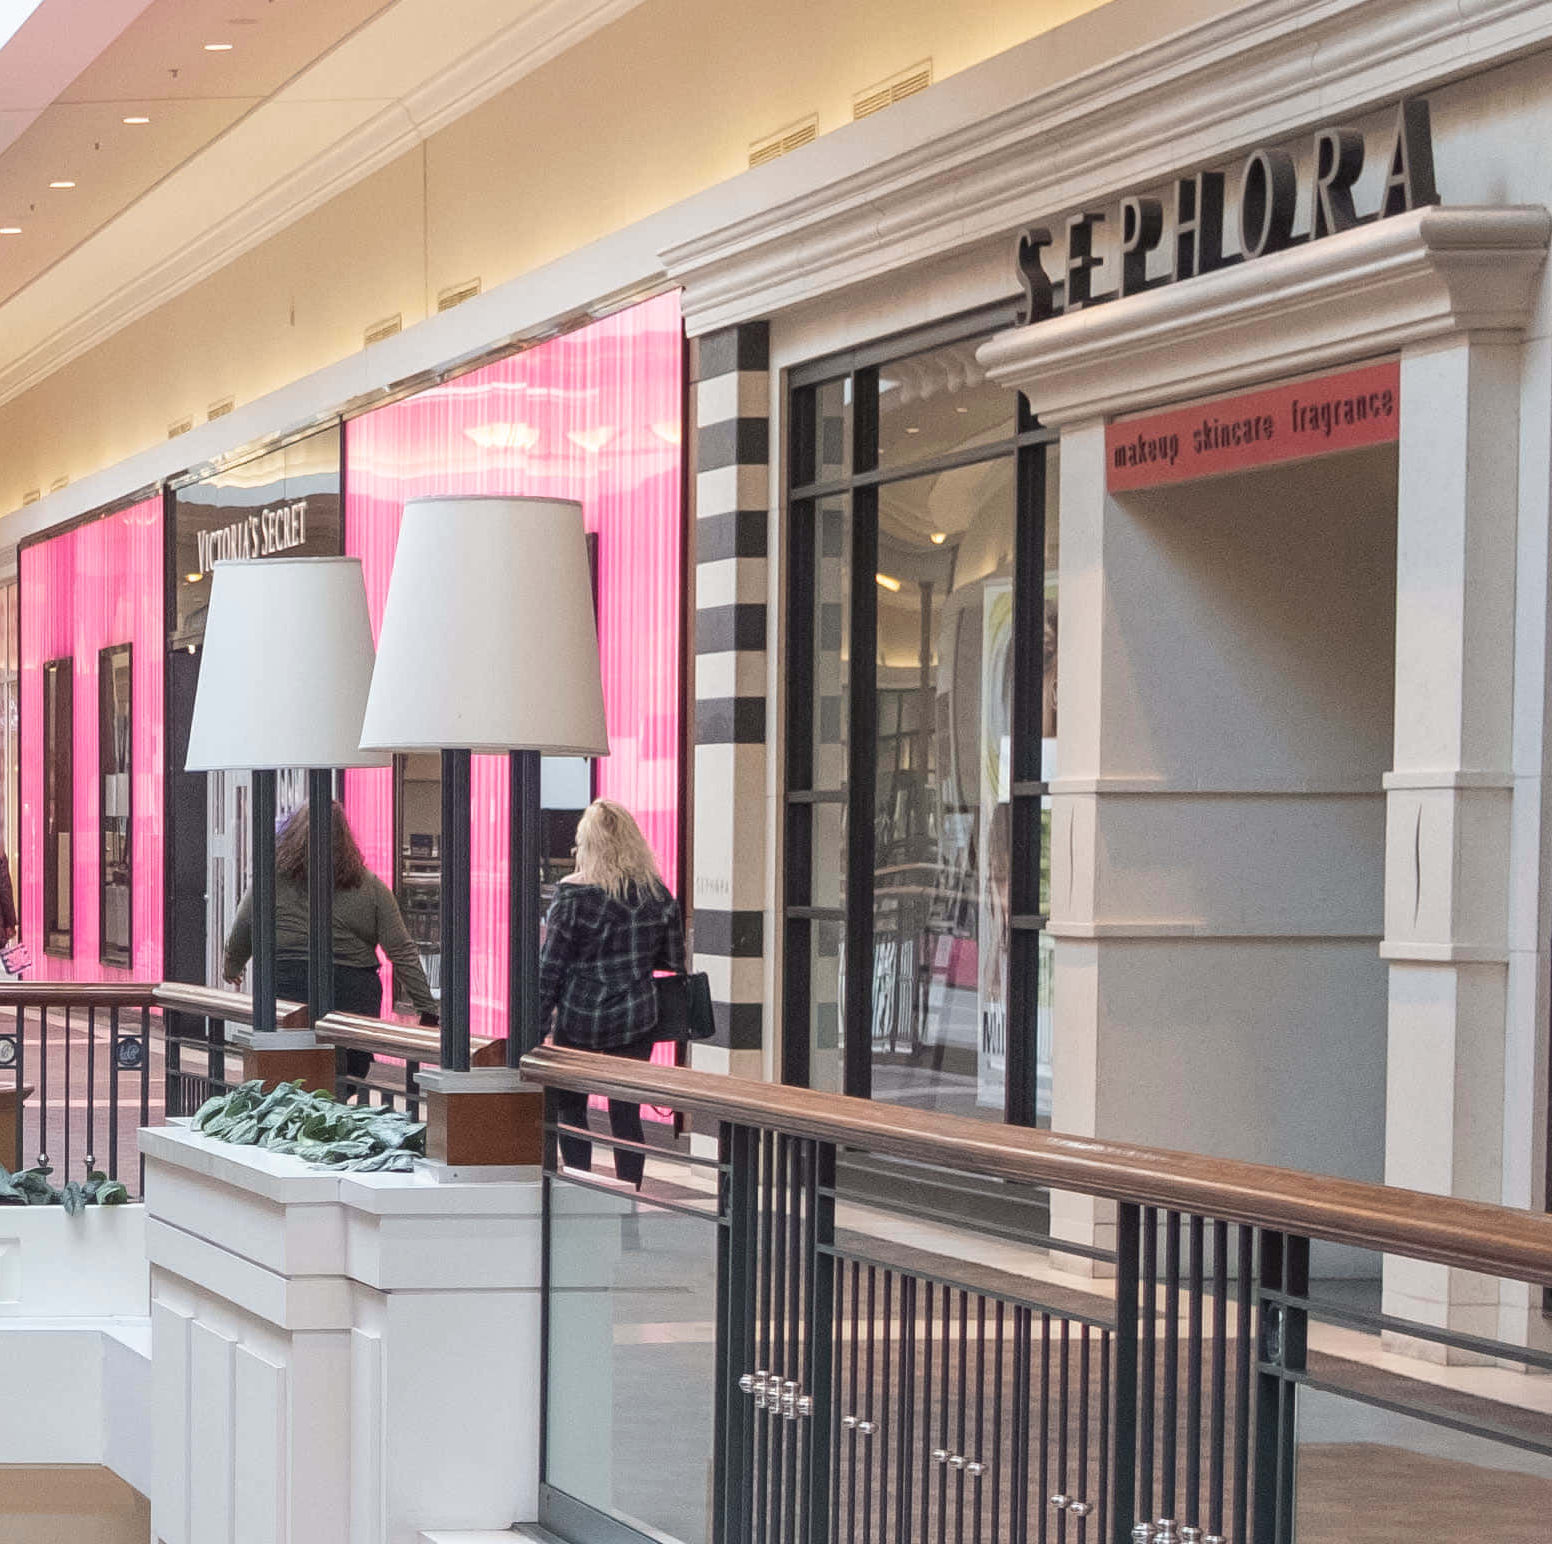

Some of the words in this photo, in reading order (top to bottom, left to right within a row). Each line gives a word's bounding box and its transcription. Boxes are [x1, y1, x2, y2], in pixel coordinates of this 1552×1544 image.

[1015, 100, 1440, 326] SEPHORA
[1113, 433, 1179, 466] makeup
[1193, 415, 1275, 454] skincare
[1292, 390, 1394, 437] fragrance
[197, 515, 259, 575] VICTORIA'S
[261, 501, 307, 555] SECRET
